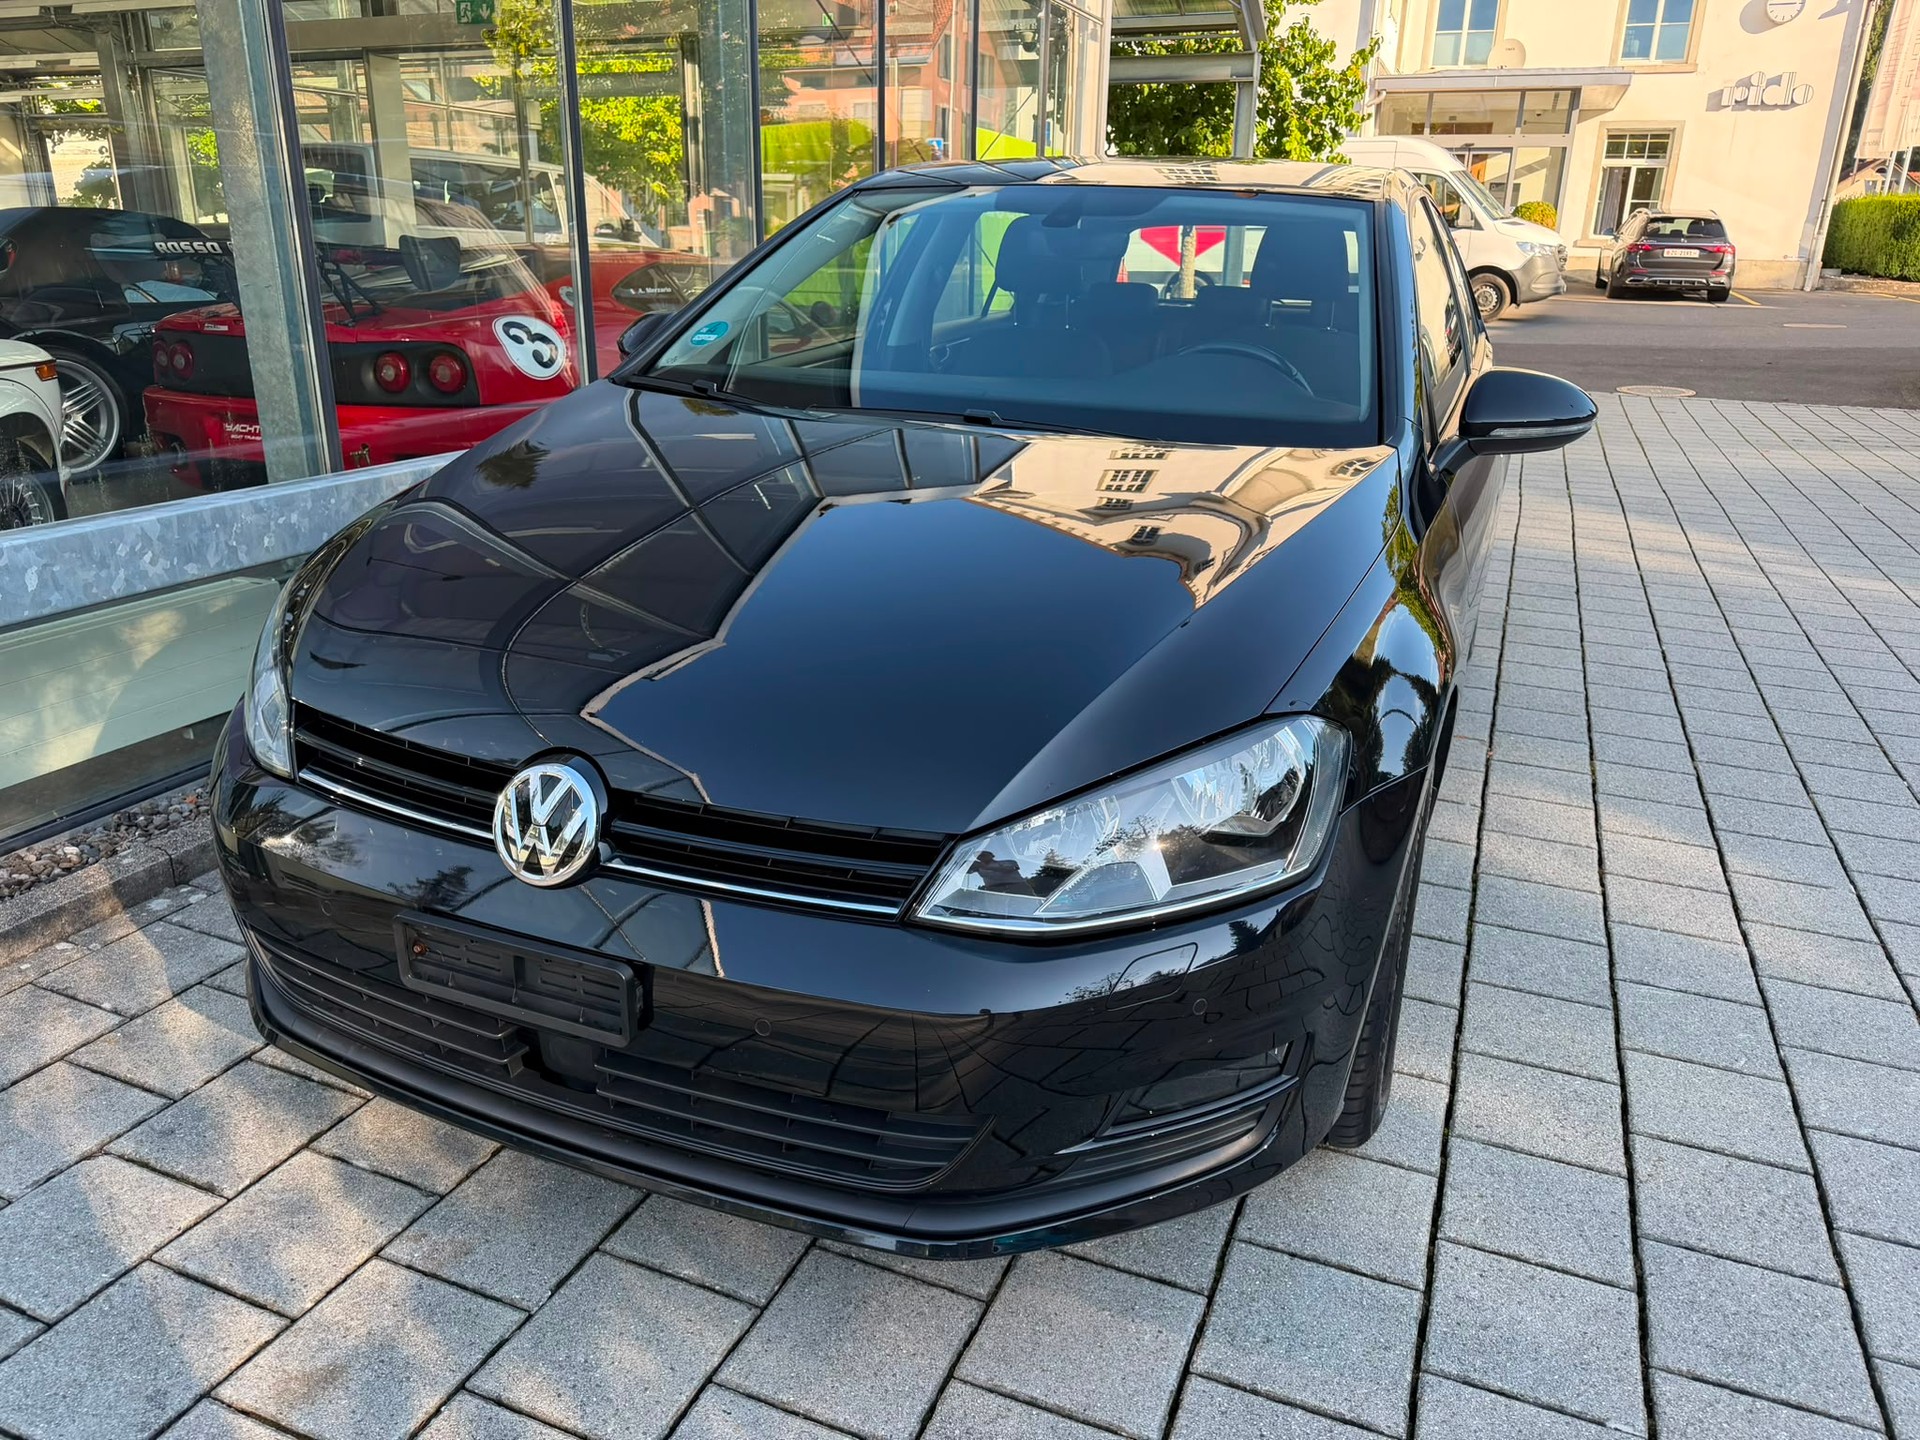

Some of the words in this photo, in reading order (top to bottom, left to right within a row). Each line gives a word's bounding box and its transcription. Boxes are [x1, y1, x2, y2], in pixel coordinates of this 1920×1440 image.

[154, 241, 223, 254] ROSSO
[502, 321, 558, 369] 3
[224, 422, 263, 434] YACHT
[493, 763, 597, 887] VW
